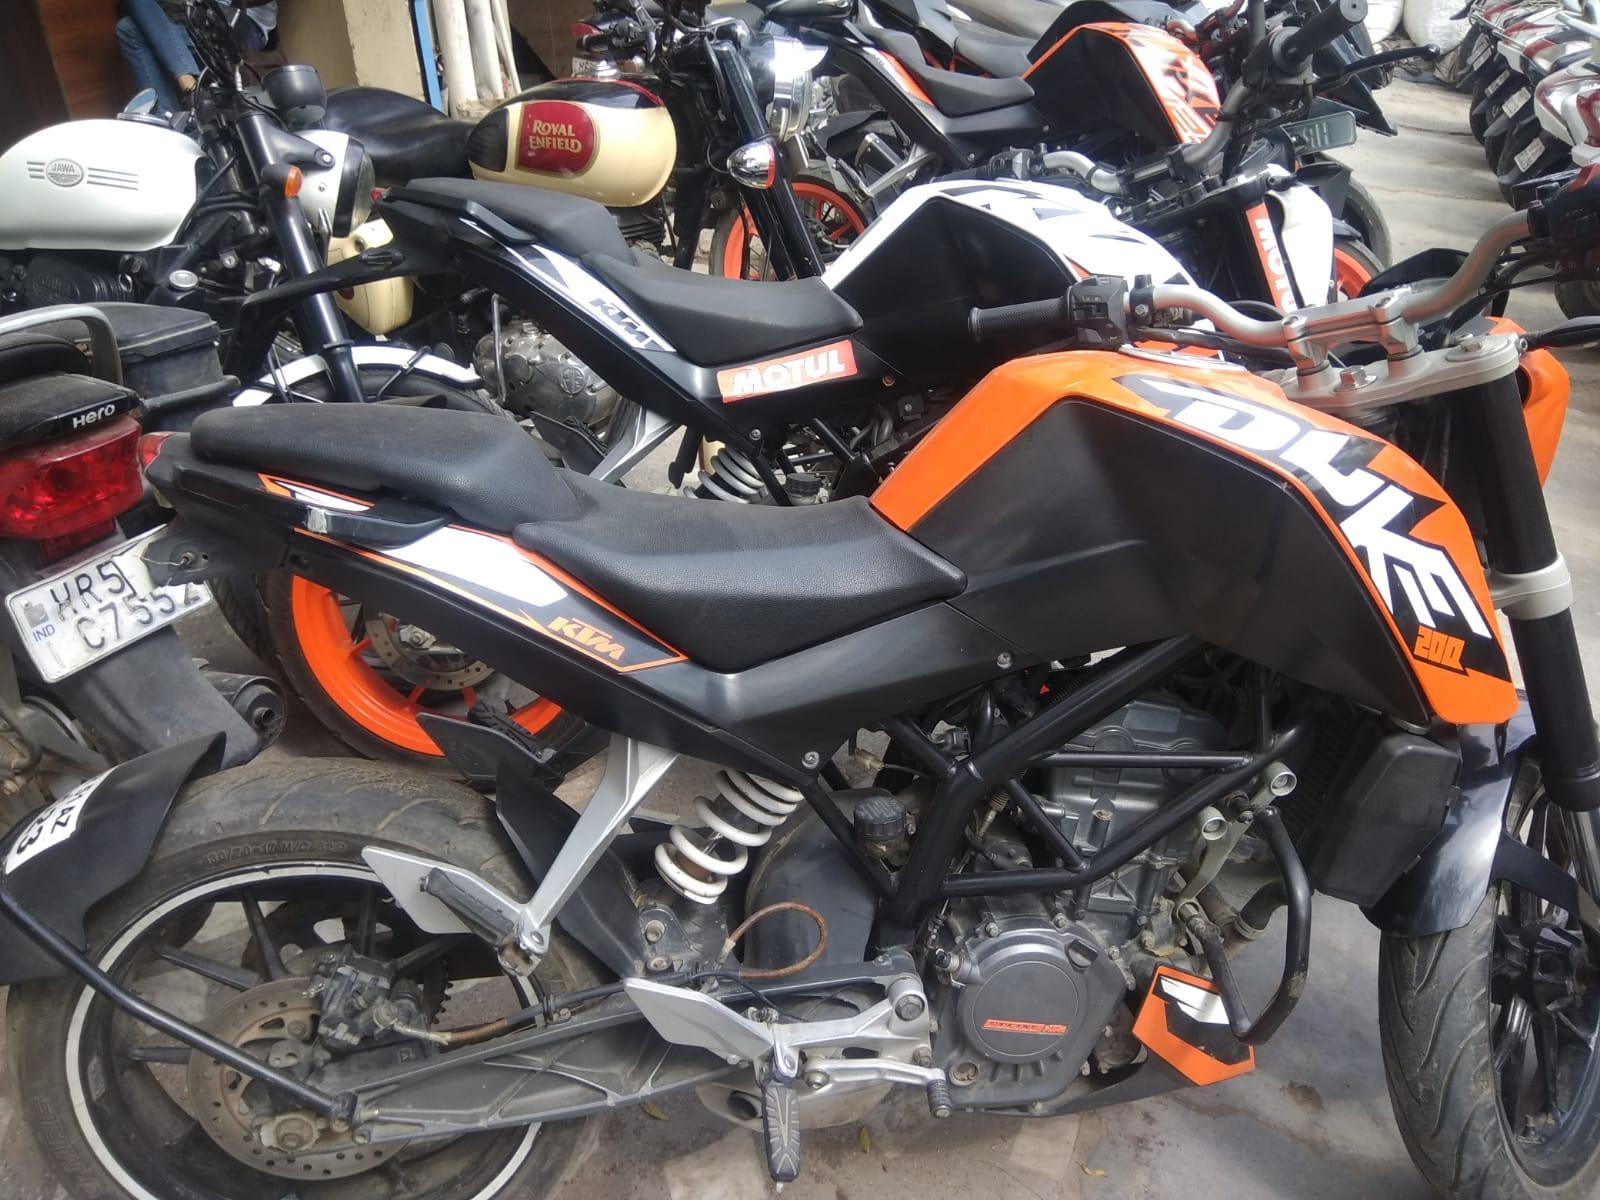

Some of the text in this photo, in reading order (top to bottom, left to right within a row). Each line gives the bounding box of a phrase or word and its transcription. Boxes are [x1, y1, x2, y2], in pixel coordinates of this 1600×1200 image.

[529, 135, 582, 154] ENFIELD
[533, 120, 576, 136] ROYAL
[52, 163, 75, 174] JAWA
[590, 298, 650, 344] KTM
[732, 350, 846, 396] MOTUL
[73, 404, 116, 429] Hero
[1141, 379, 1493, 639] DUKE
[33, 624, 56, 642] IND
[547, 616, 625, 661] KTM
[1413, 624, 1466, 670] 200
